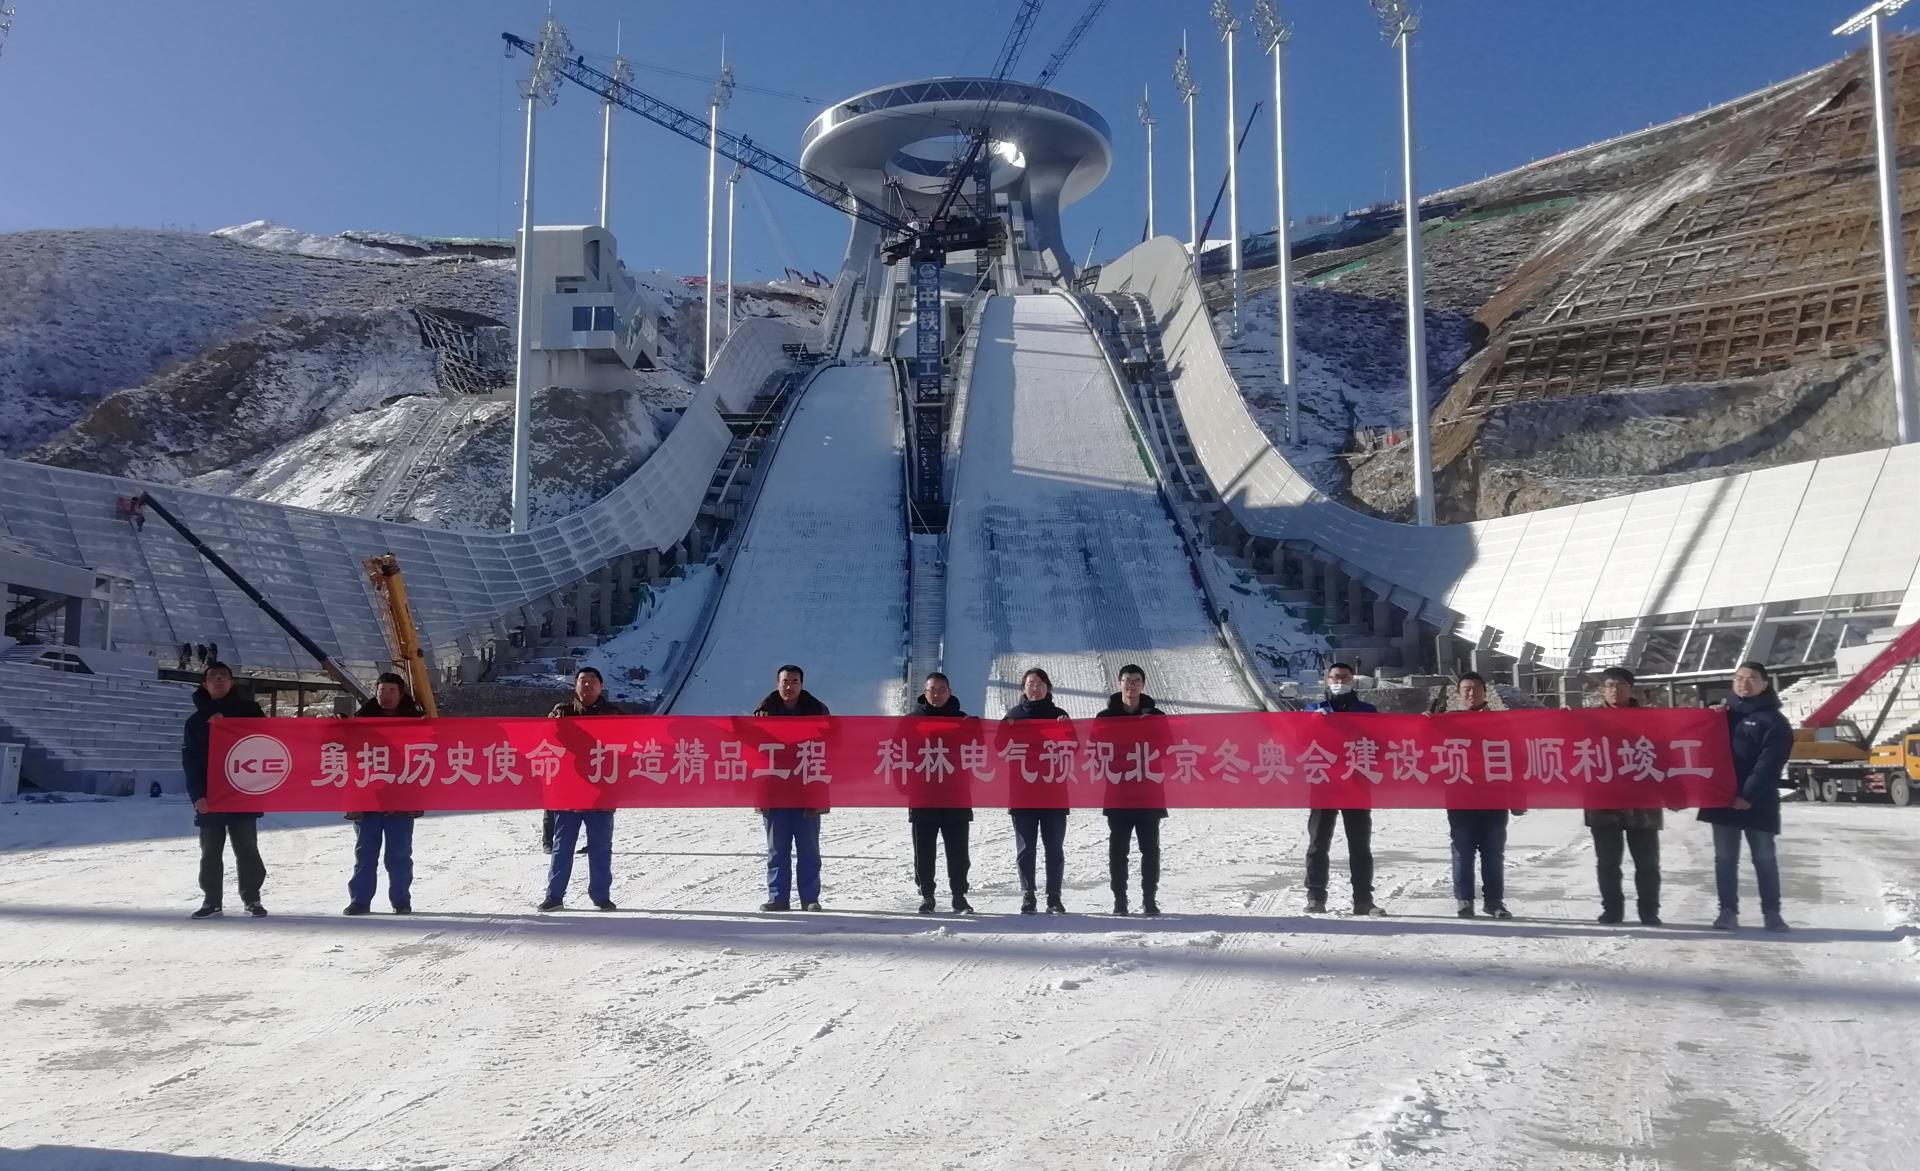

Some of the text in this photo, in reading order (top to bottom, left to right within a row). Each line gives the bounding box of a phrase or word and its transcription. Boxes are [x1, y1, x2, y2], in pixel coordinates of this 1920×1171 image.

[919, 287, 939, 376] 中铁建工
[233, 758, 285, 774] KE
[311, 736, 1714, 787] 勇担历史使命 打造精品工程 科林电气预祝北京冬奥会建设项目顺利竣工
